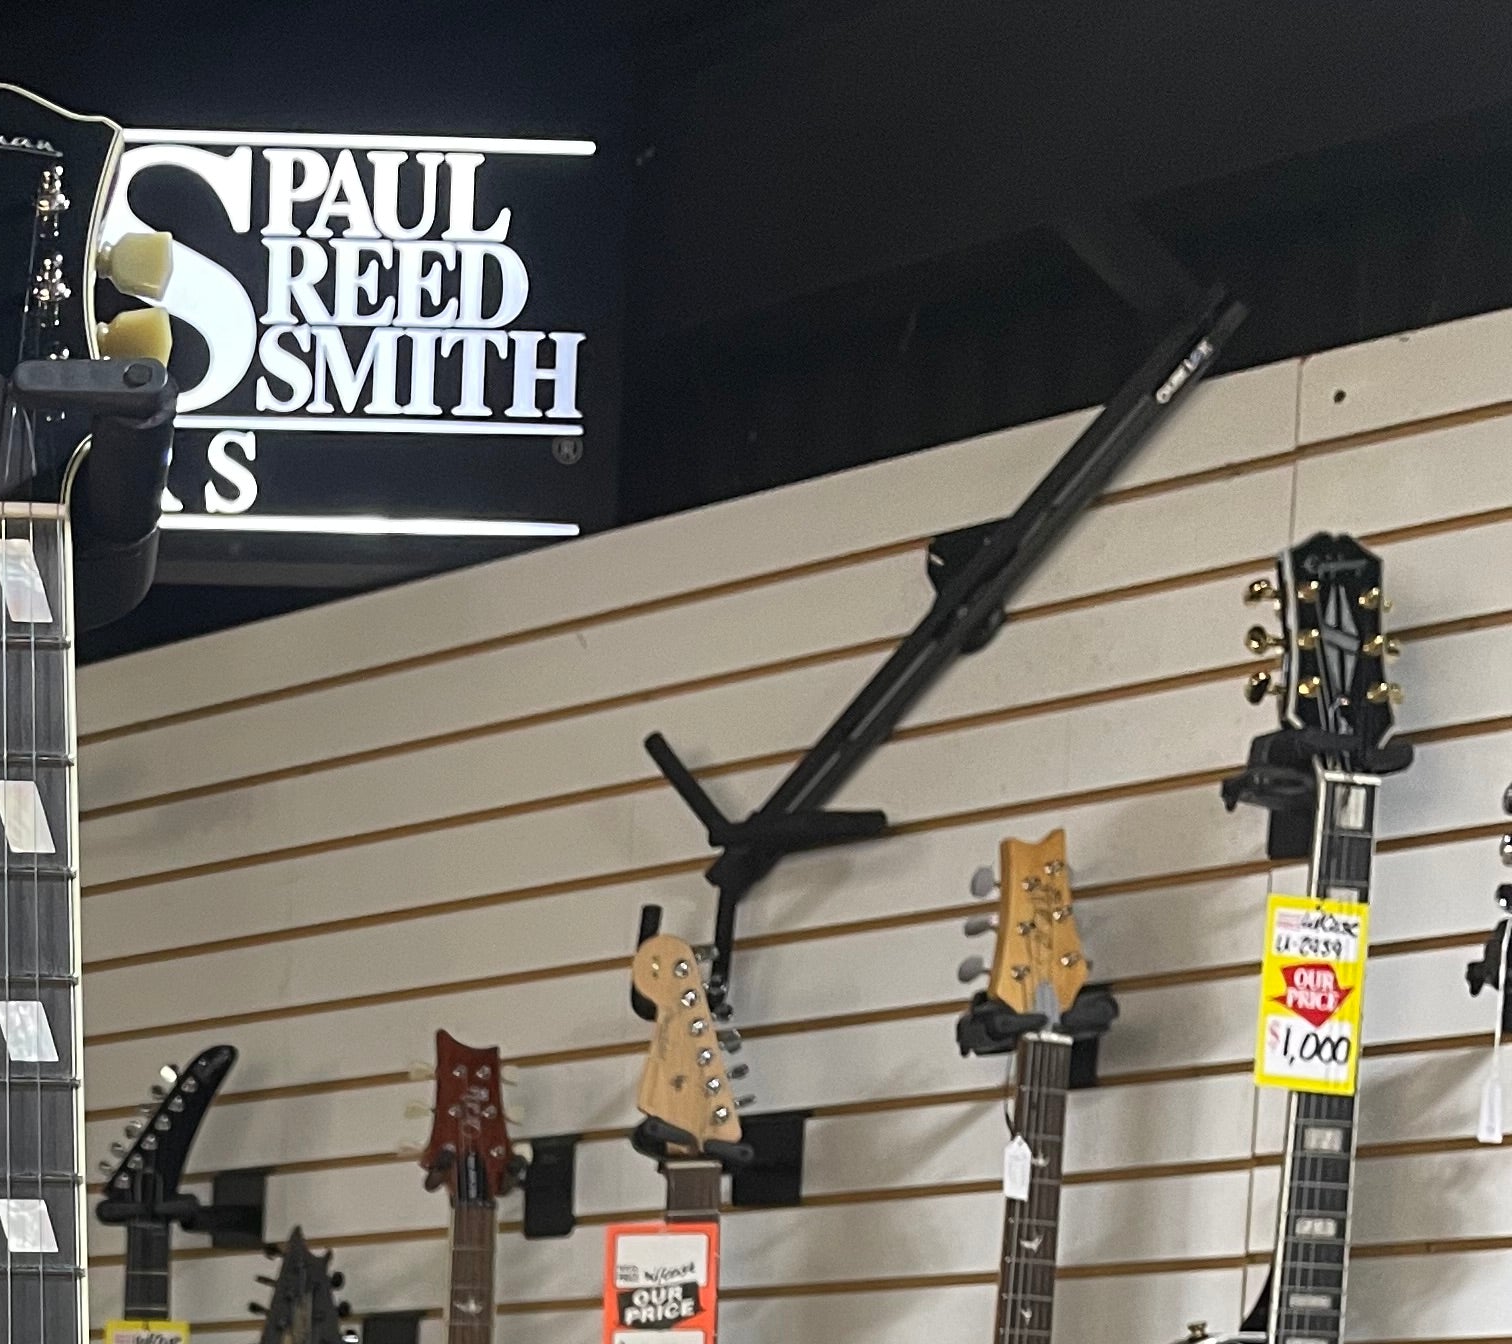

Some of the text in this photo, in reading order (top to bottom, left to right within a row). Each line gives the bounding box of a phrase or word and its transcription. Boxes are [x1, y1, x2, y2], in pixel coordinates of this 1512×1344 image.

[260, 148, 511, 242] PAUL
[259, 237, 530, 329] REED
[256, 324, 587, 419] SMITH
[1293, 967, 1335, 990] OUR
[1286, 987, 1340, 1012] PRICE
[632, 1286, 683, 1307] OUR
[624, 1298, 695, 1326] PRICE
